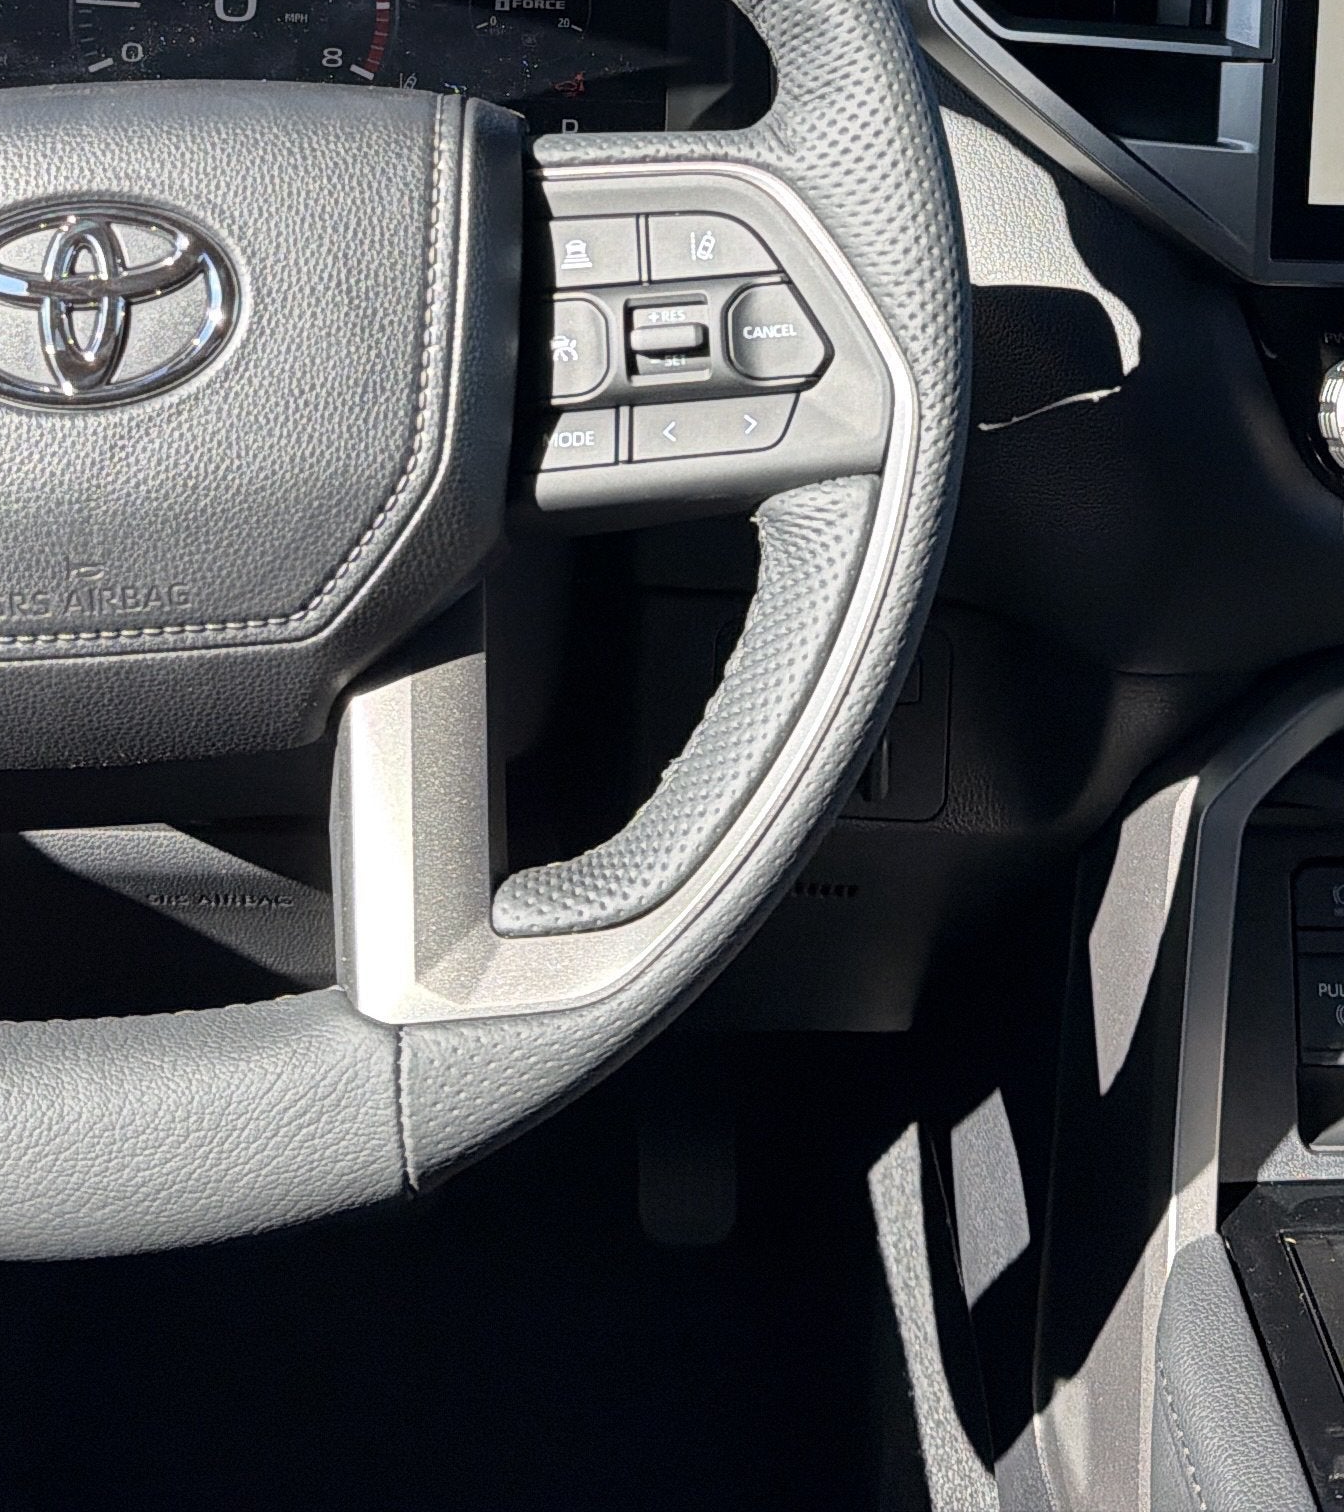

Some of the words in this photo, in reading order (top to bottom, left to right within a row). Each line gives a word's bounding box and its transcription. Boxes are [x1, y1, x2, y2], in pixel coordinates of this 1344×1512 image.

[284, 12, 309, 24] MPH
[489, 15, 498, 27] 0
[557, 17, 571, 29] 20
[120, 41, 145, 63] 0
[321, 47, 344, 68] 8
[743, 322, 798, 339] CANCEL
[62, 582, 193, 617] AIRBAG
